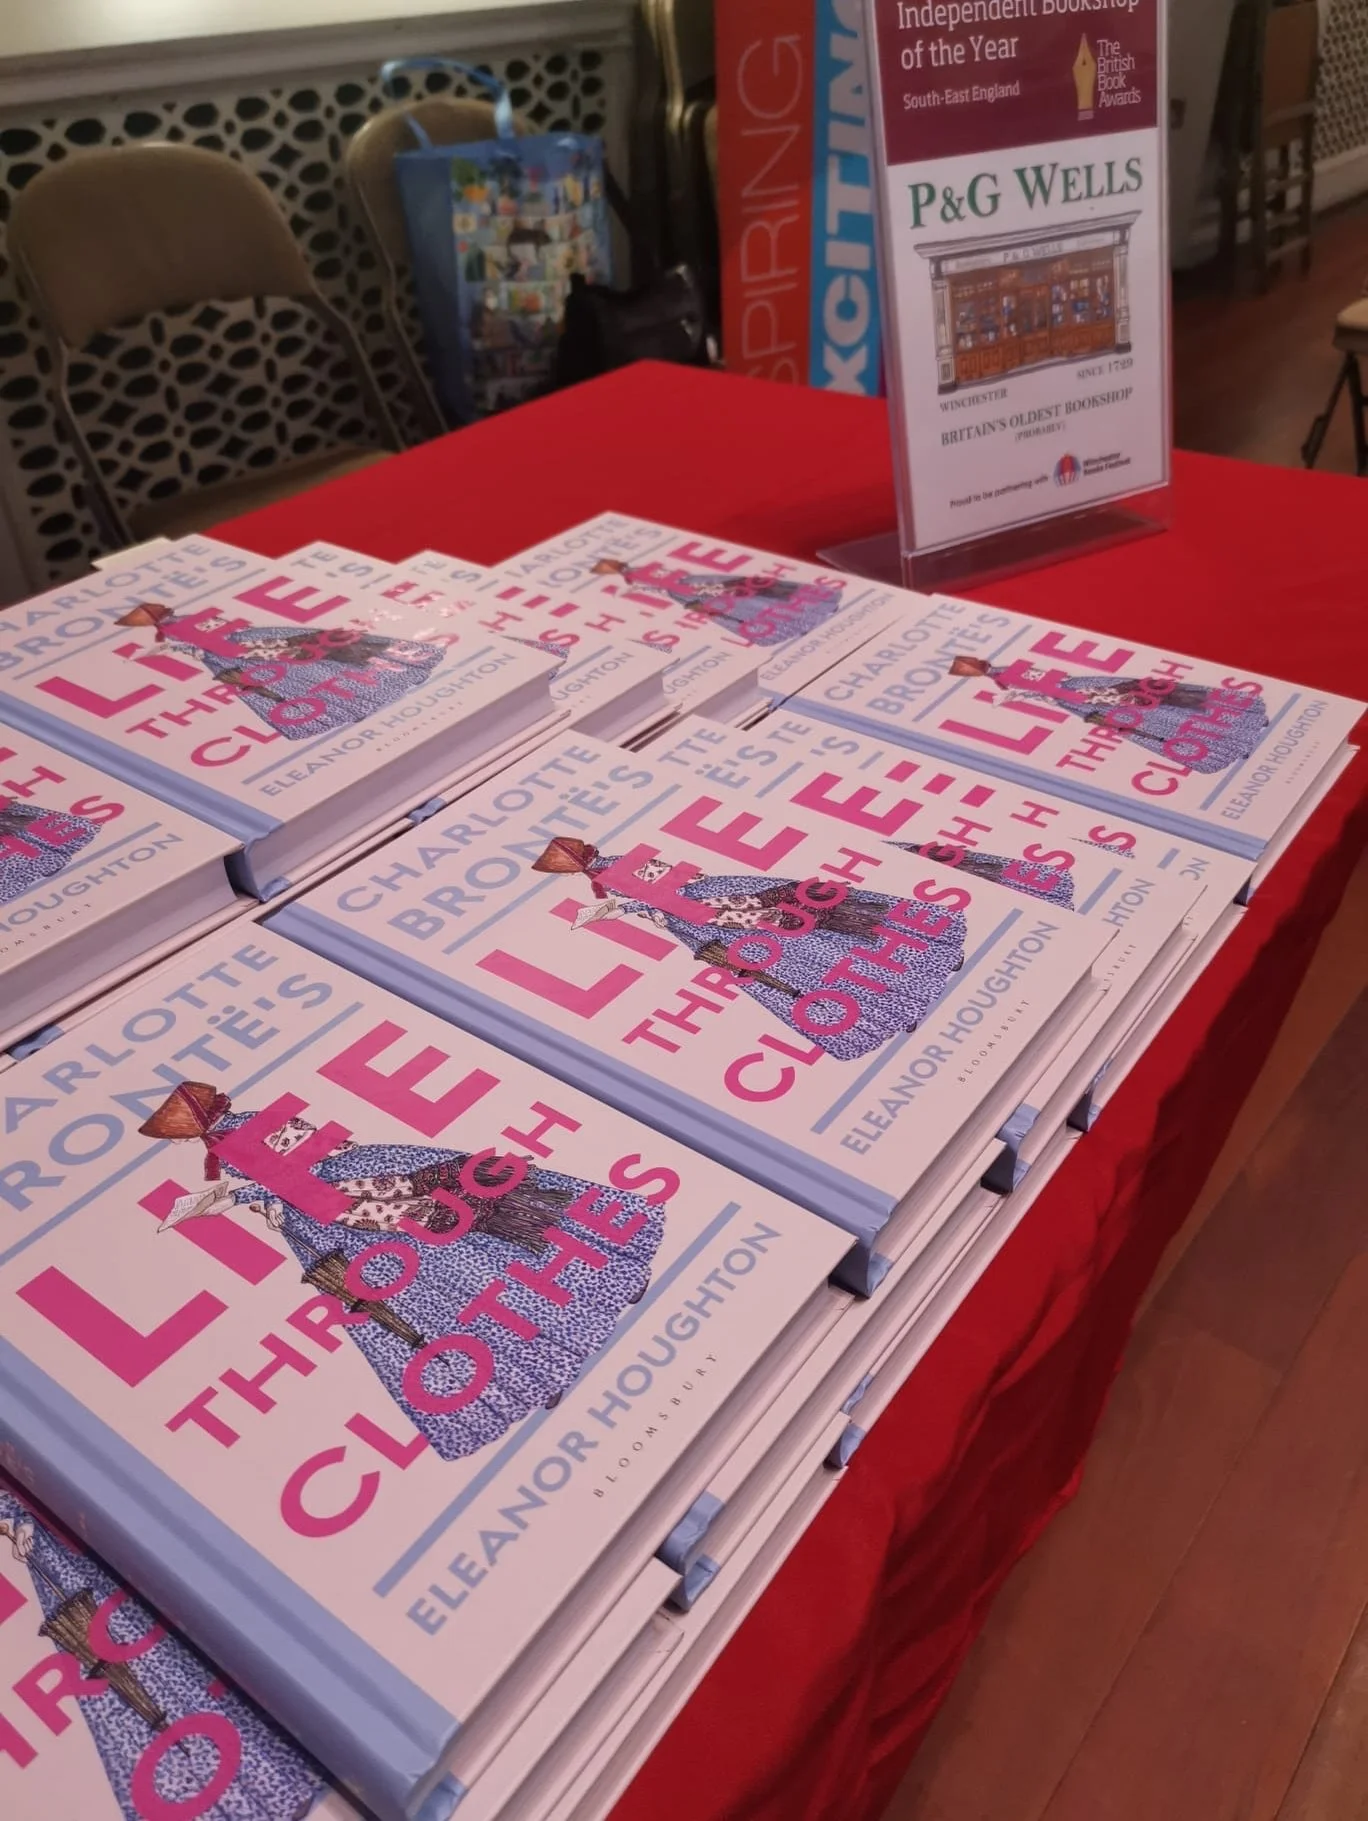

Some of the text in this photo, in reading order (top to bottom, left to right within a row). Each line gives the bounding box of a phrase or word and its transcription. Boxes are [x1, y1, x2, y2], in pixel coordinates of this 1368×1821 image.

[898, 0, 1037, 31] Independent
[901, 35, 1020, 70] of the Year
[1096, 39, 1121, 57] The
[1097, 54, 1136, 76] British
[903, 80, 1021, 110] South-East England
[1098, 71, 1127, 91] Book
[1098, 87, 1142, 107] Awards
[907, 157, 1144, 229] P&G WELLS
[939, 388, 1008, 413] WINCHESTER
[941, 387, 1134, 446] BRITAIN'S OLDEST BOOKSHOP
[1077, 365, 1104, 380] SINCE
[35, 575, 351, 719] LIFE
[824, 603, 966, 701] CHARLOTTE
[937, 630, 1135, 756] LIFE
[259, 728, 383, 797] ELEANOR
[382, 653, 517, 730] HOUGHTON
[1056, 659, 1193, 772] THROUGH
[1131, 676, 1264, 796] CLOTHES
[1221, 764, 1278, 821] ELEANOR
[1269, 699, 1330, 768] HOUGHTON
[336, 744, 602, 913] CHARLOTTE
[387, 764, 655, 941] BRONTË'S
[475, 795, 809, 1020] LIFE
[621, 846, 883, 1054] THROUGH
[724, 878, 972, 1103] CLOTHES
[839, 1043, 956, 1156] ELEANOR
[945, 920, 1061, 1060] HOUGHTON
[957, 998, 1031, 1084] BLOOMSBURY
[15, 1019, 502, 1389] LIFE
[165, 1100, 582, 1448] THROUGH
[280, 1153, 681, 1538] CLOTHES
[406, 1221, 784, 1636] ELEANOR HOUGHTON
[592, 1350, 720, 1500] BLOOMSBURY
